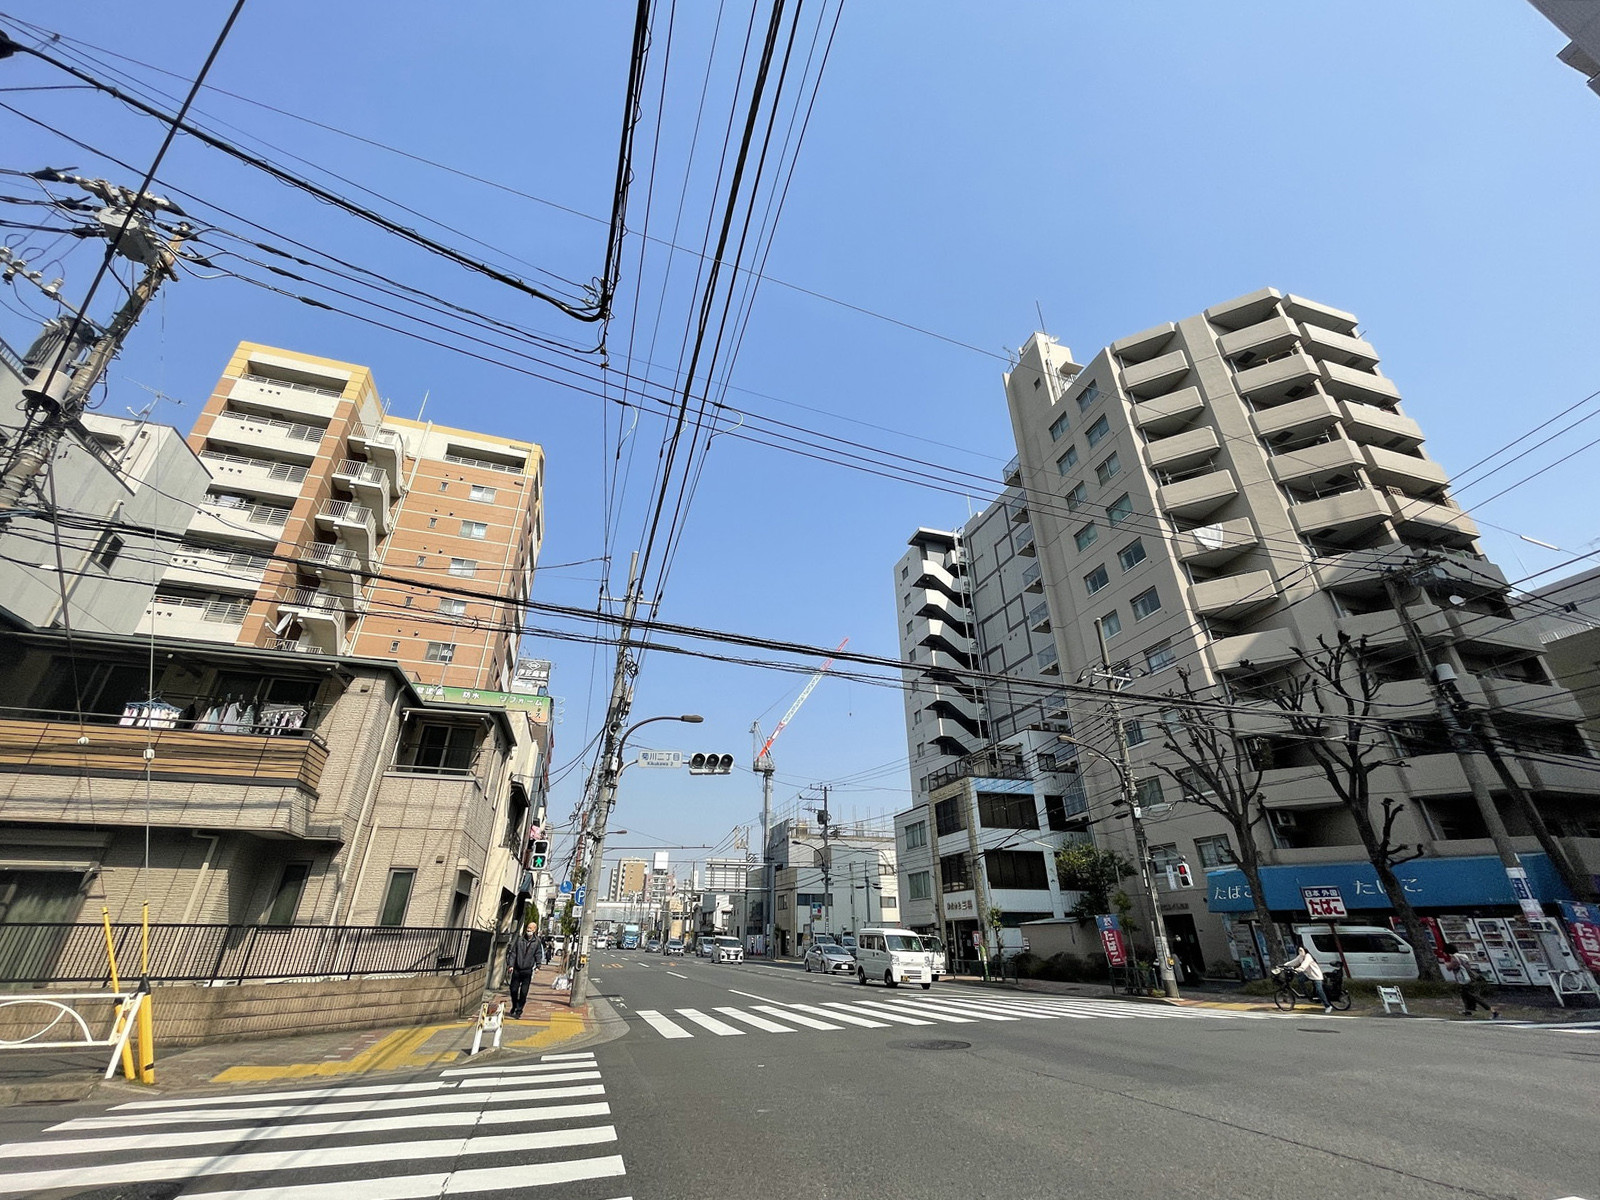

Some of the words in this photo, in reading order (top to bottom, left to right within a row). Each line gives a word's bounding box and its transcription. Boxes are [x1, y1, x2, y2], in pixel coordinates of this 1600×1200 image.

[499, 695, 543, 706] リフォーム
[642, 752, 680, 761] 菊川二丁目
[1309, 898, 1345, 916] たばこ
[1104, 931, 1121, 962] たばこ
